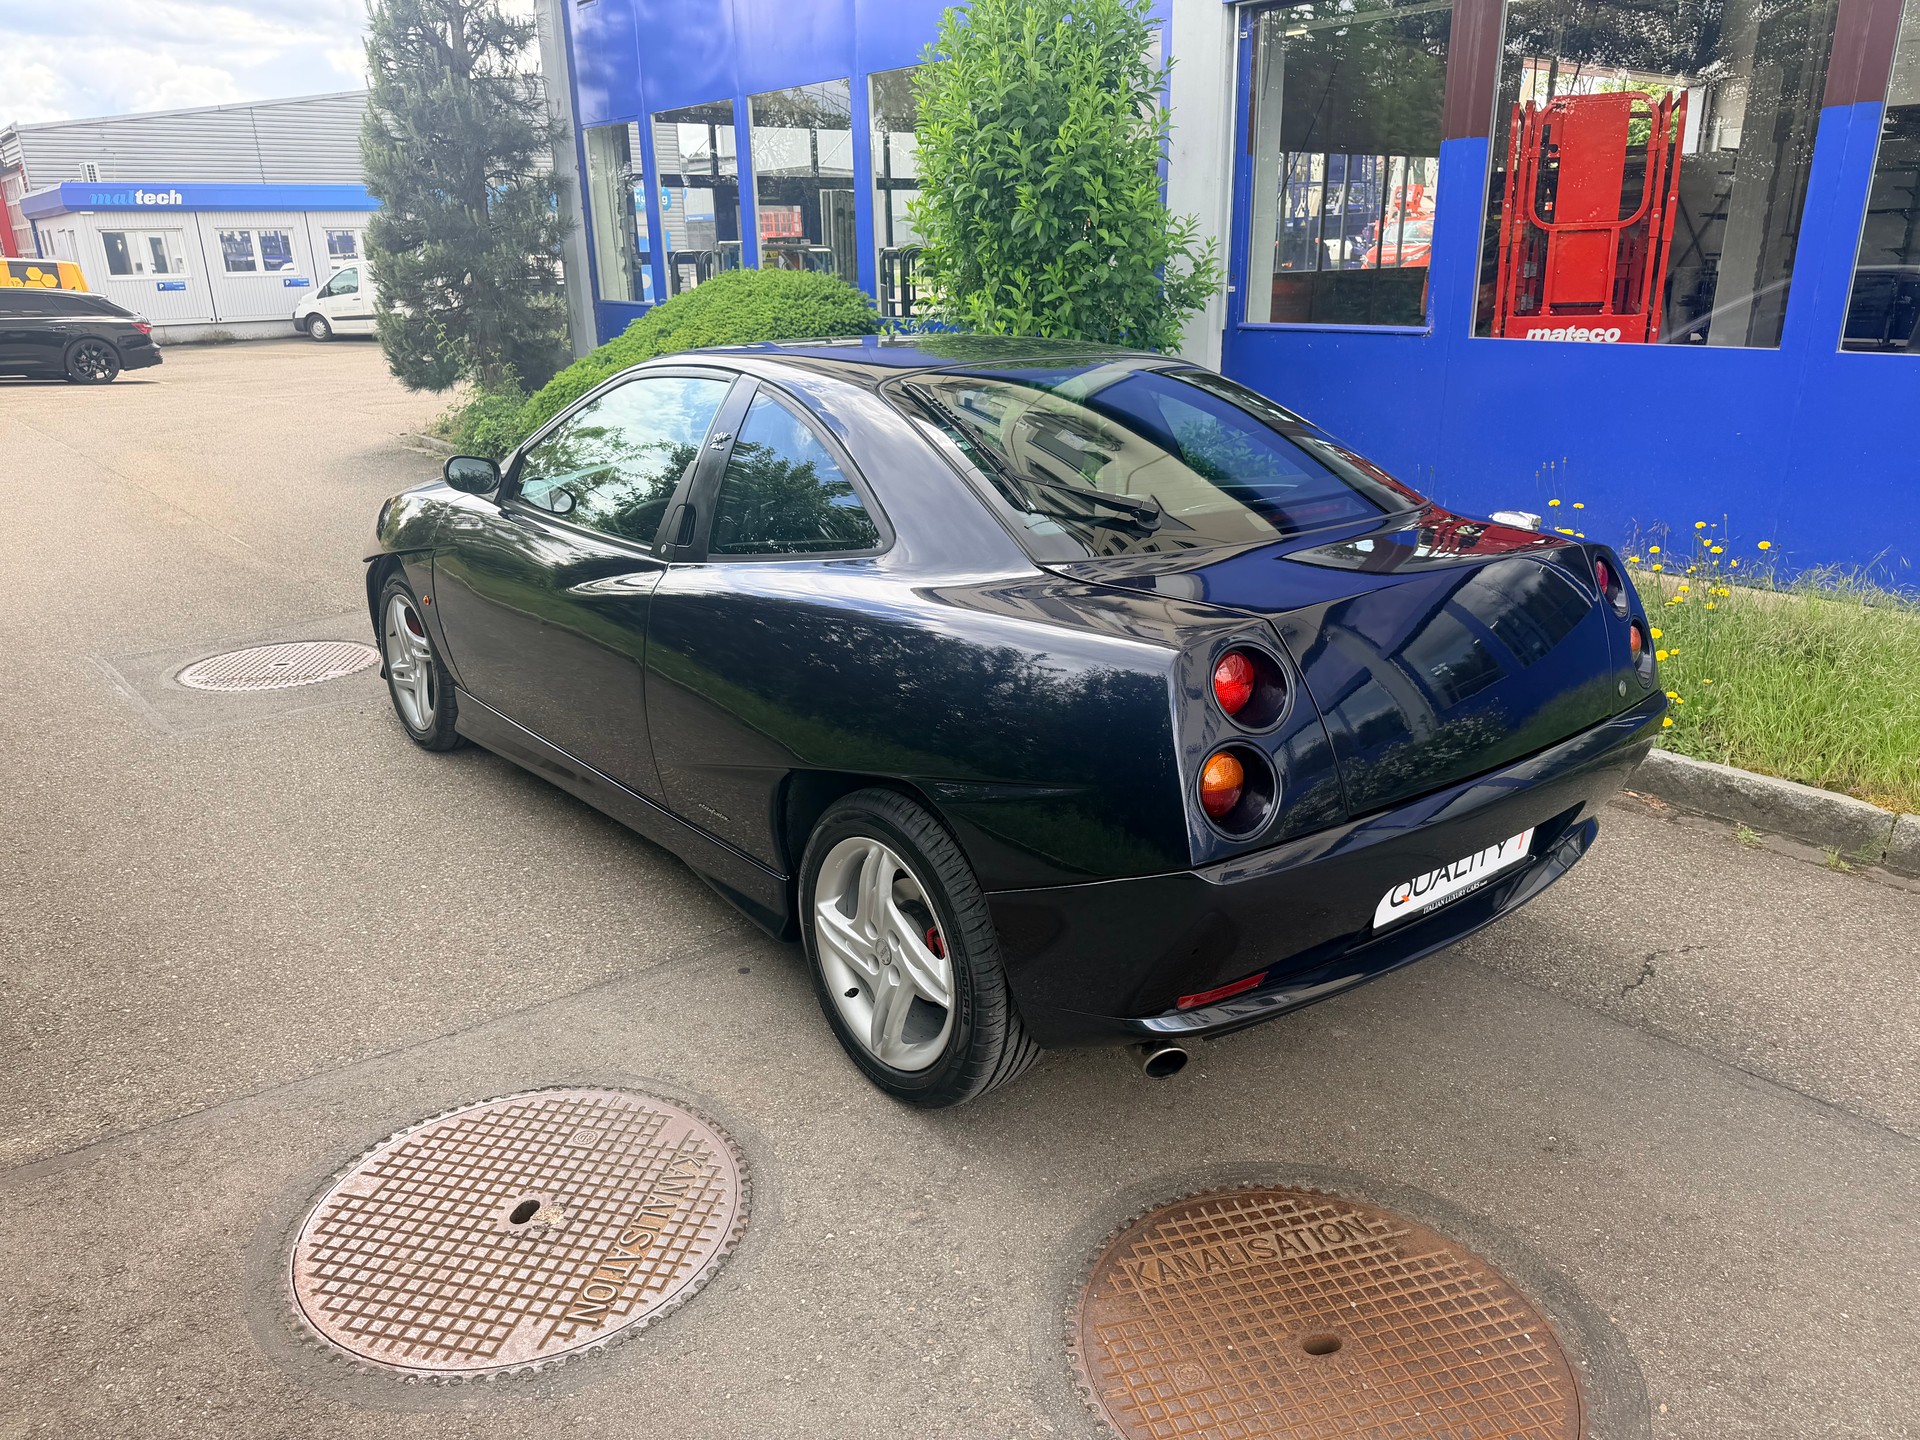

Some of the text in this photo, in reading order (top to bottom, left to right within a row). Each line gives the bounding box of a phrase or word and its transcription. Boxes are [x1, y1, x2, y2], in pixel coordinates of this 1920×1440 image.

[89, 189, 183, 205] maltech
[1526, 325, 1621, 343] mateco
[564, 1152, 702, 1324] KANALISATION
[1128, 1215, 1371, 1289] KANALISATION
